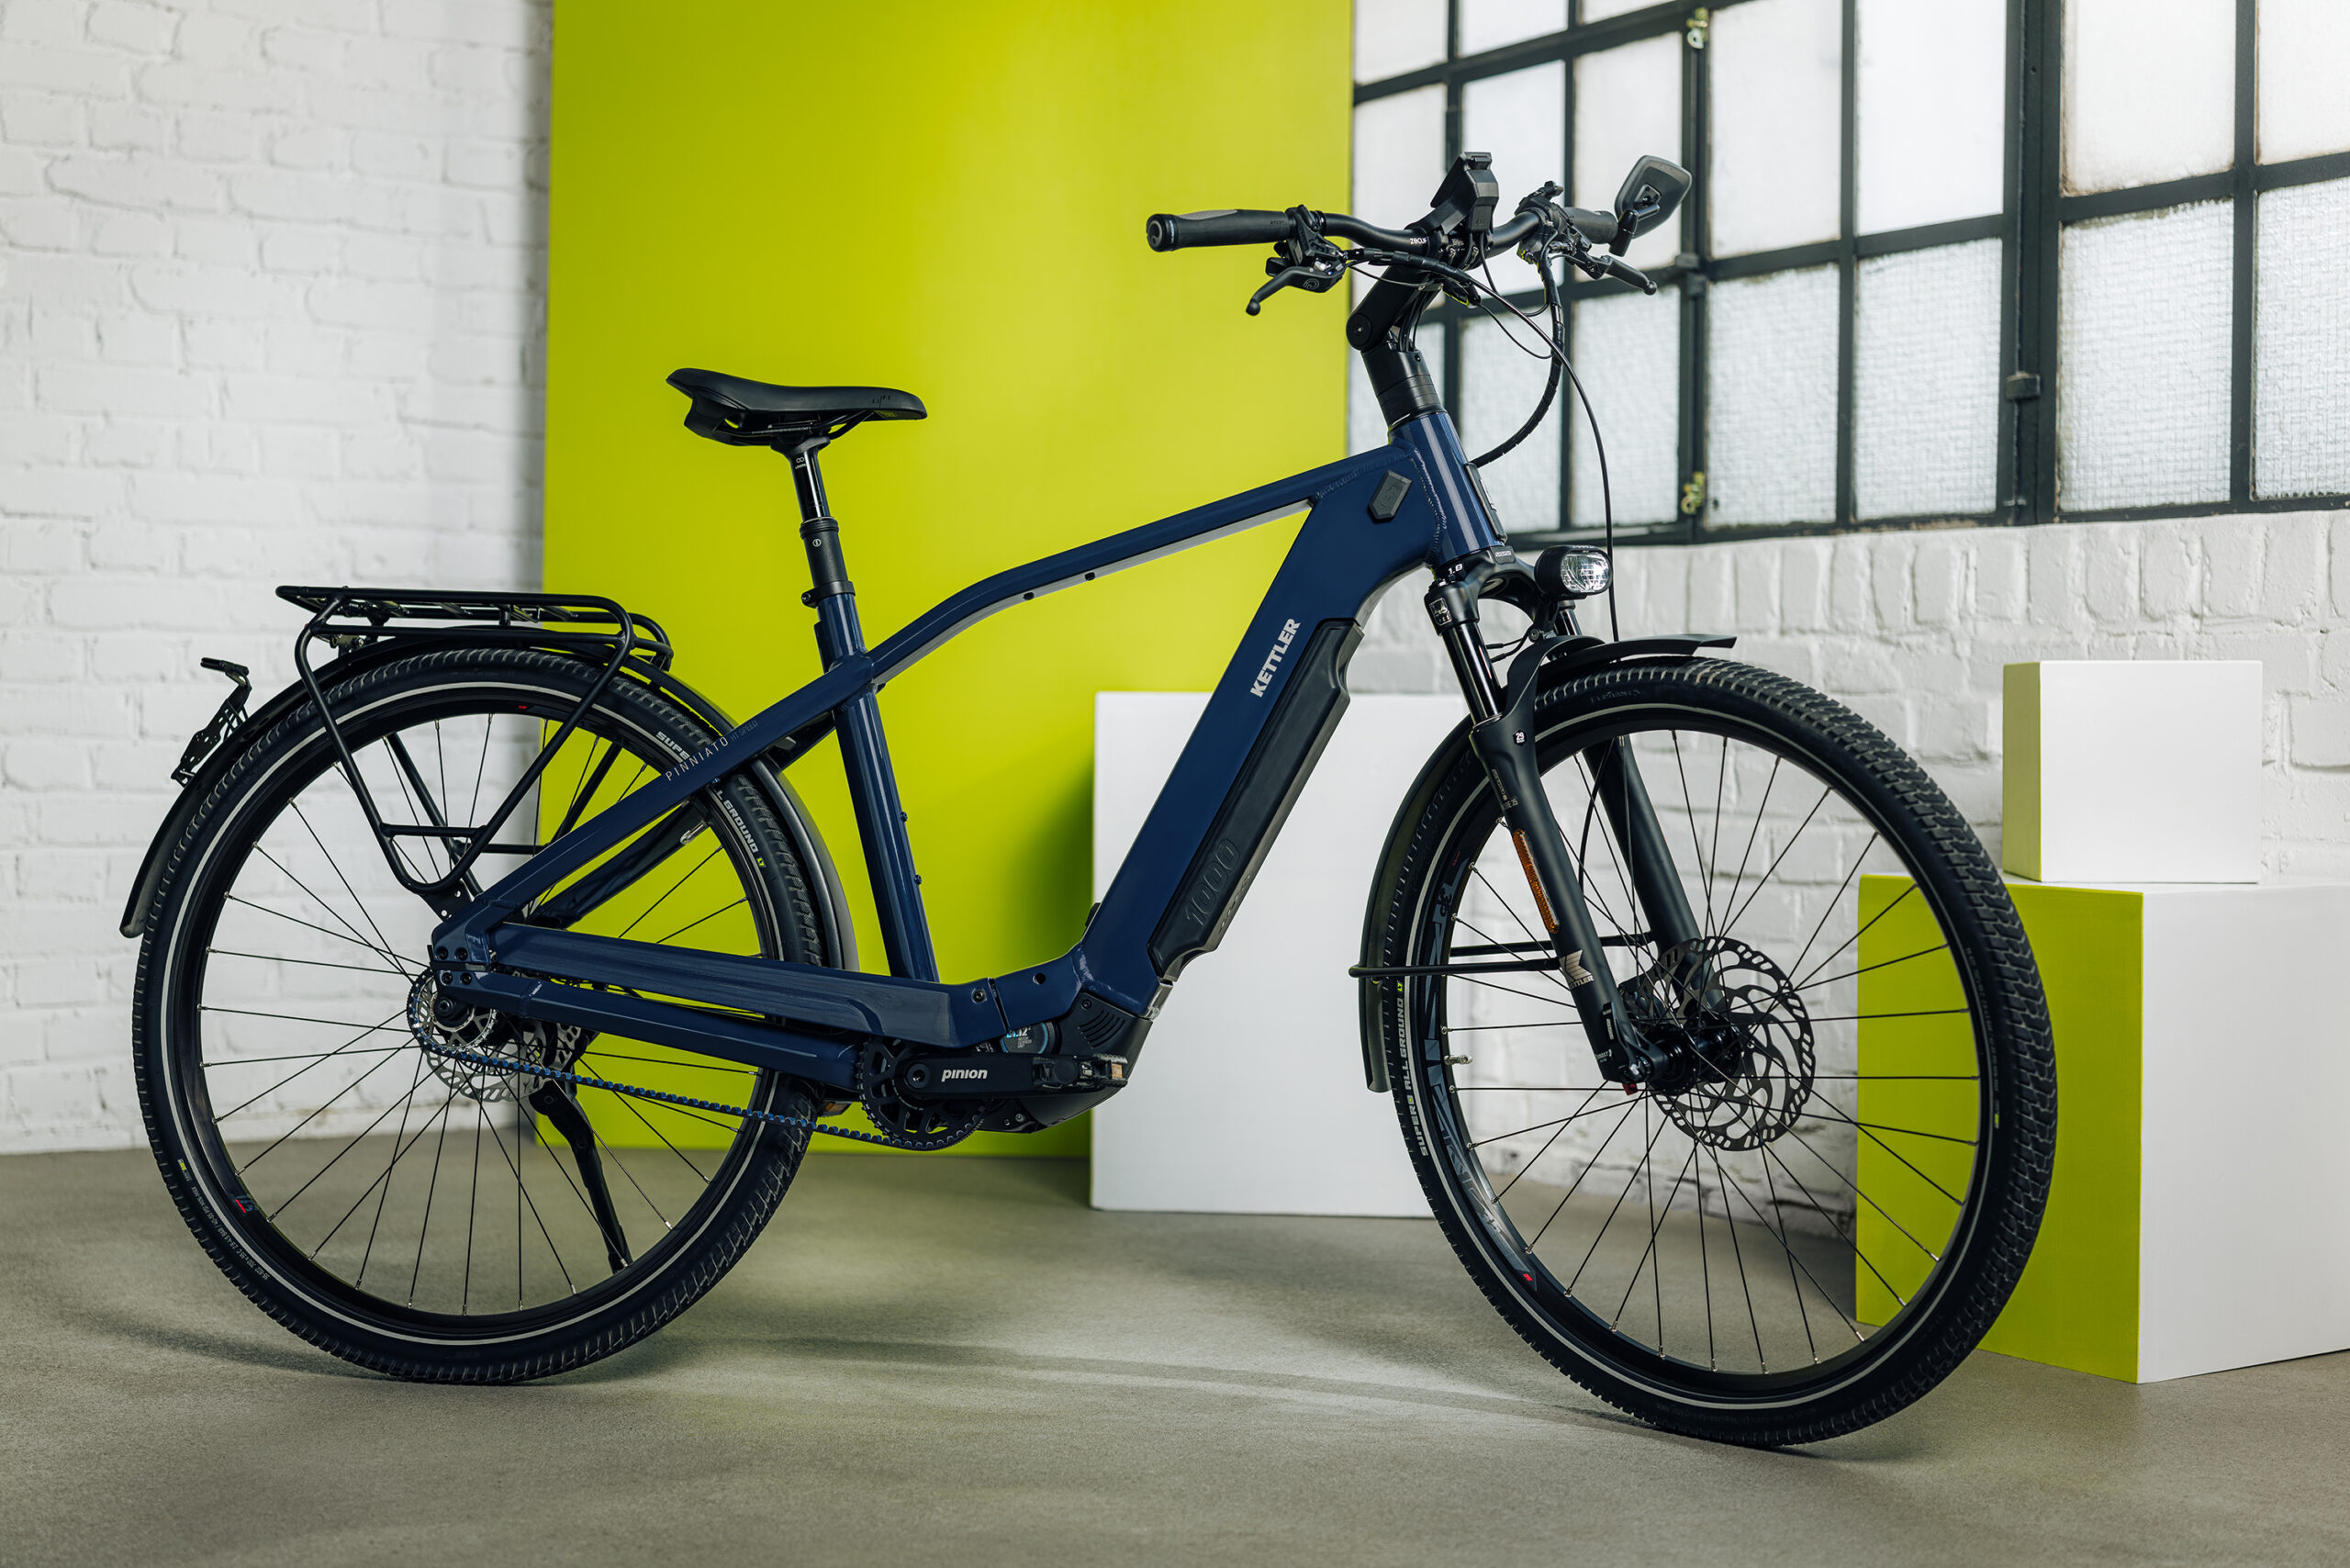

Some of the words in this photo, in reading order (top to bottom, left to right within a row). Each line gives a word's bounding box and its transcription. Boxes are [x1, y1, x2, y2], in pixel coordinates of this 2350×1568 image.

[1249, 618, 1301, 698] KETTLER
[655, 731, 690, 760] SUPE
[665, 736, 729, 781] PINNIATO
[739, 720, 758, 736] SPEED
[723, 800, 759, 854] GROUND
[1184, 838, 1241, 927] 1000
[1396, 997, 1407, 1058] GROUND
[941, 1070, 988, 1082] pinion
[1402, 1060, 1413, 1091] ALL
[1407, 1094, 1429, 1156] SUPERO
